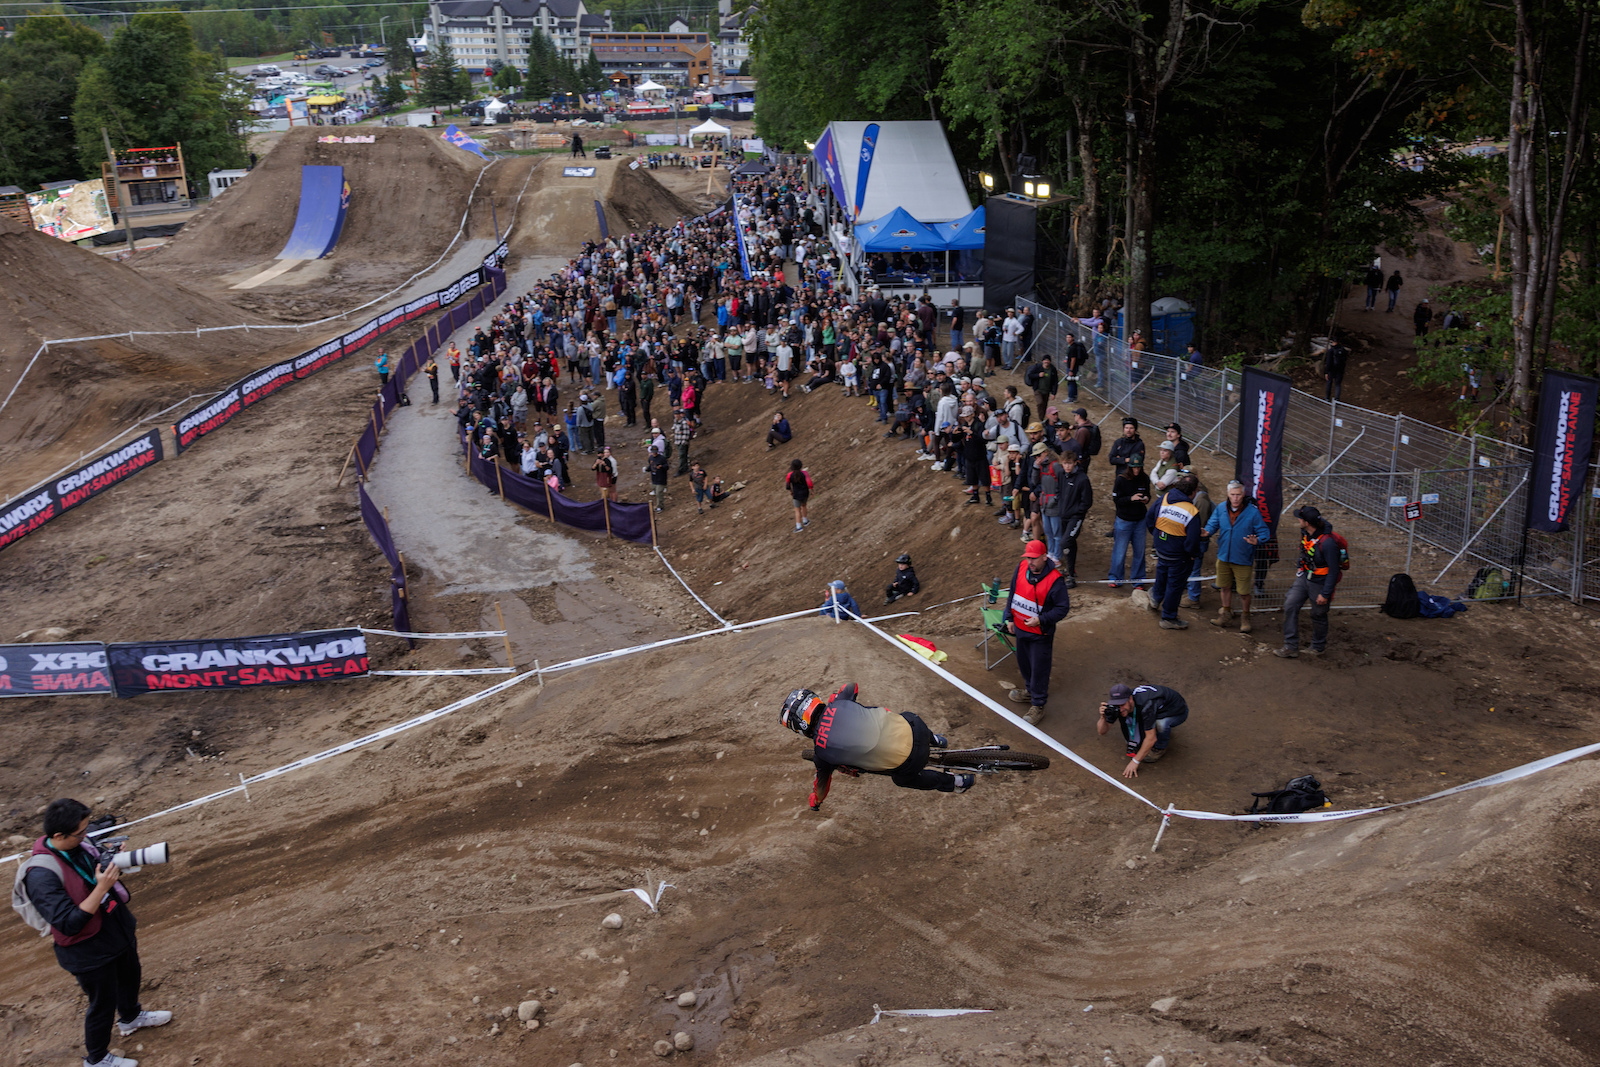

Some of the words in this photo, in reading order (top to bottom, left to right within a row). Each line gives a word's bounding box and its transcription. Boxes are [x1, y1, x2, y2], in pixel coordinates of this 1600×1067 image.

[242, 363, 293, 394] CRANKWORX
[295, 339, 341, 369] CRANKWORX
[180, 389, 239, 434] CRANKWORX
[181, 400, 240, 446] MONT-SAINTE-ANNE
[56, 436, 153, 495] CRANKWORX
[60, 449, 155, 509] MONT-SAINTE-ANNE
[1549, 391, 1571, 521] CRANKWORX
[1557, 392, 1581, 523] MONT-SAINTE-ANNE
